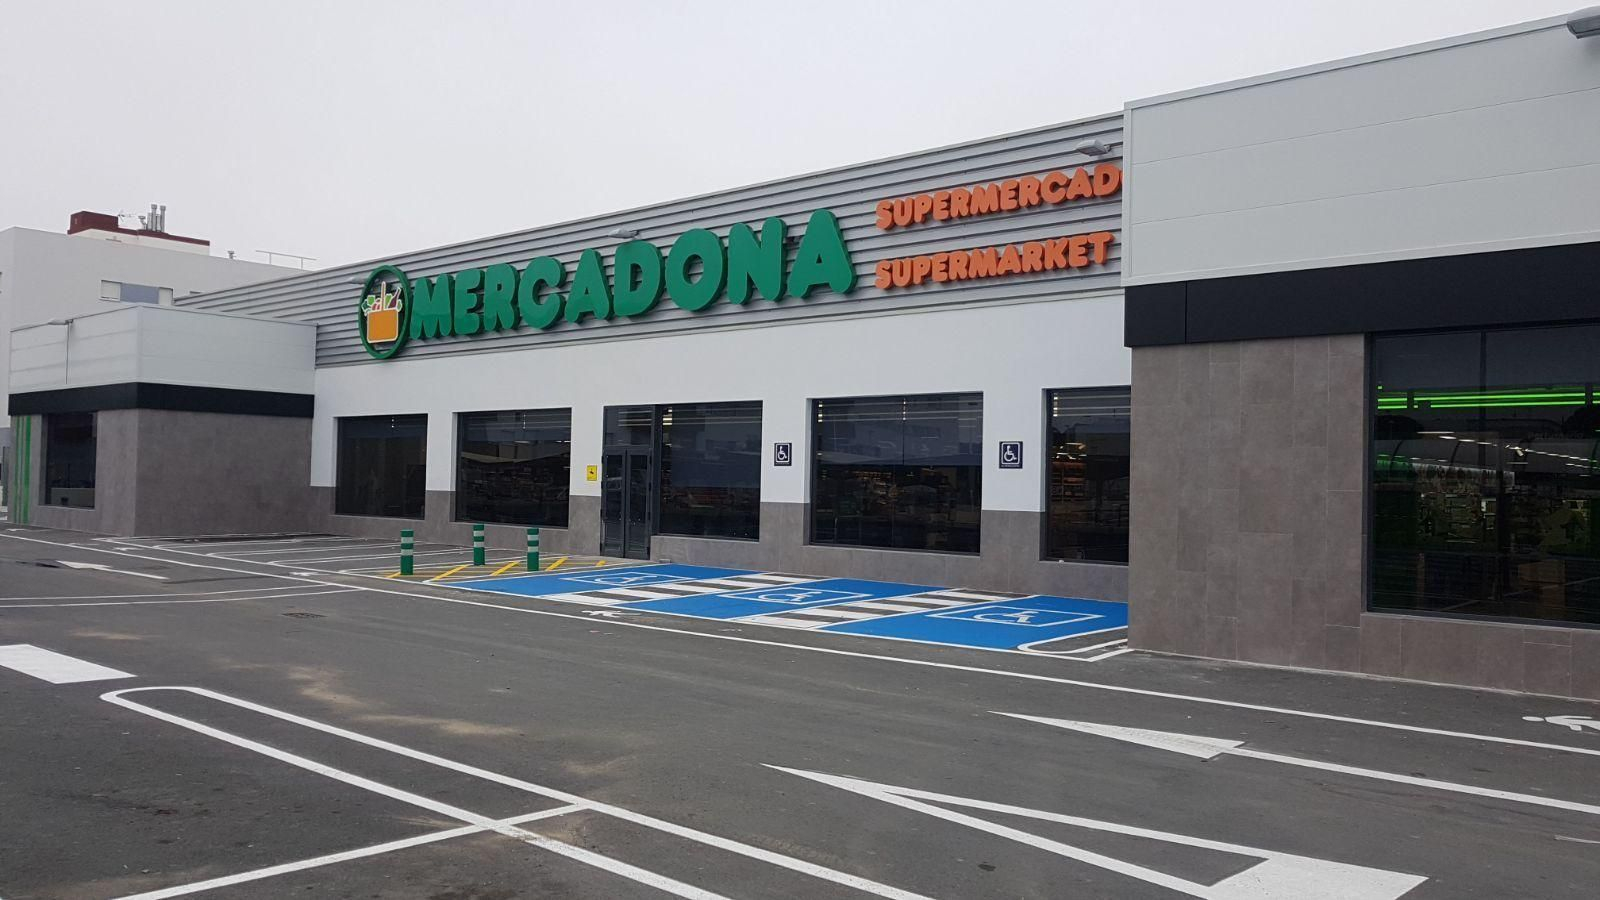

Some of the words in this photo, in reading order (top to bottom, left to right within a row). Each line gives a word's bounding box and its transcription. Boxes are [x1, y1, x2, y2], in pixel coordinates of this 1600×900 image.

[875, 163, 1121, 230] SUPERMERCAD
[409, 208, 856, 341] MERCADONA
[874, 231, 1115, 289] SUPERMARKET
